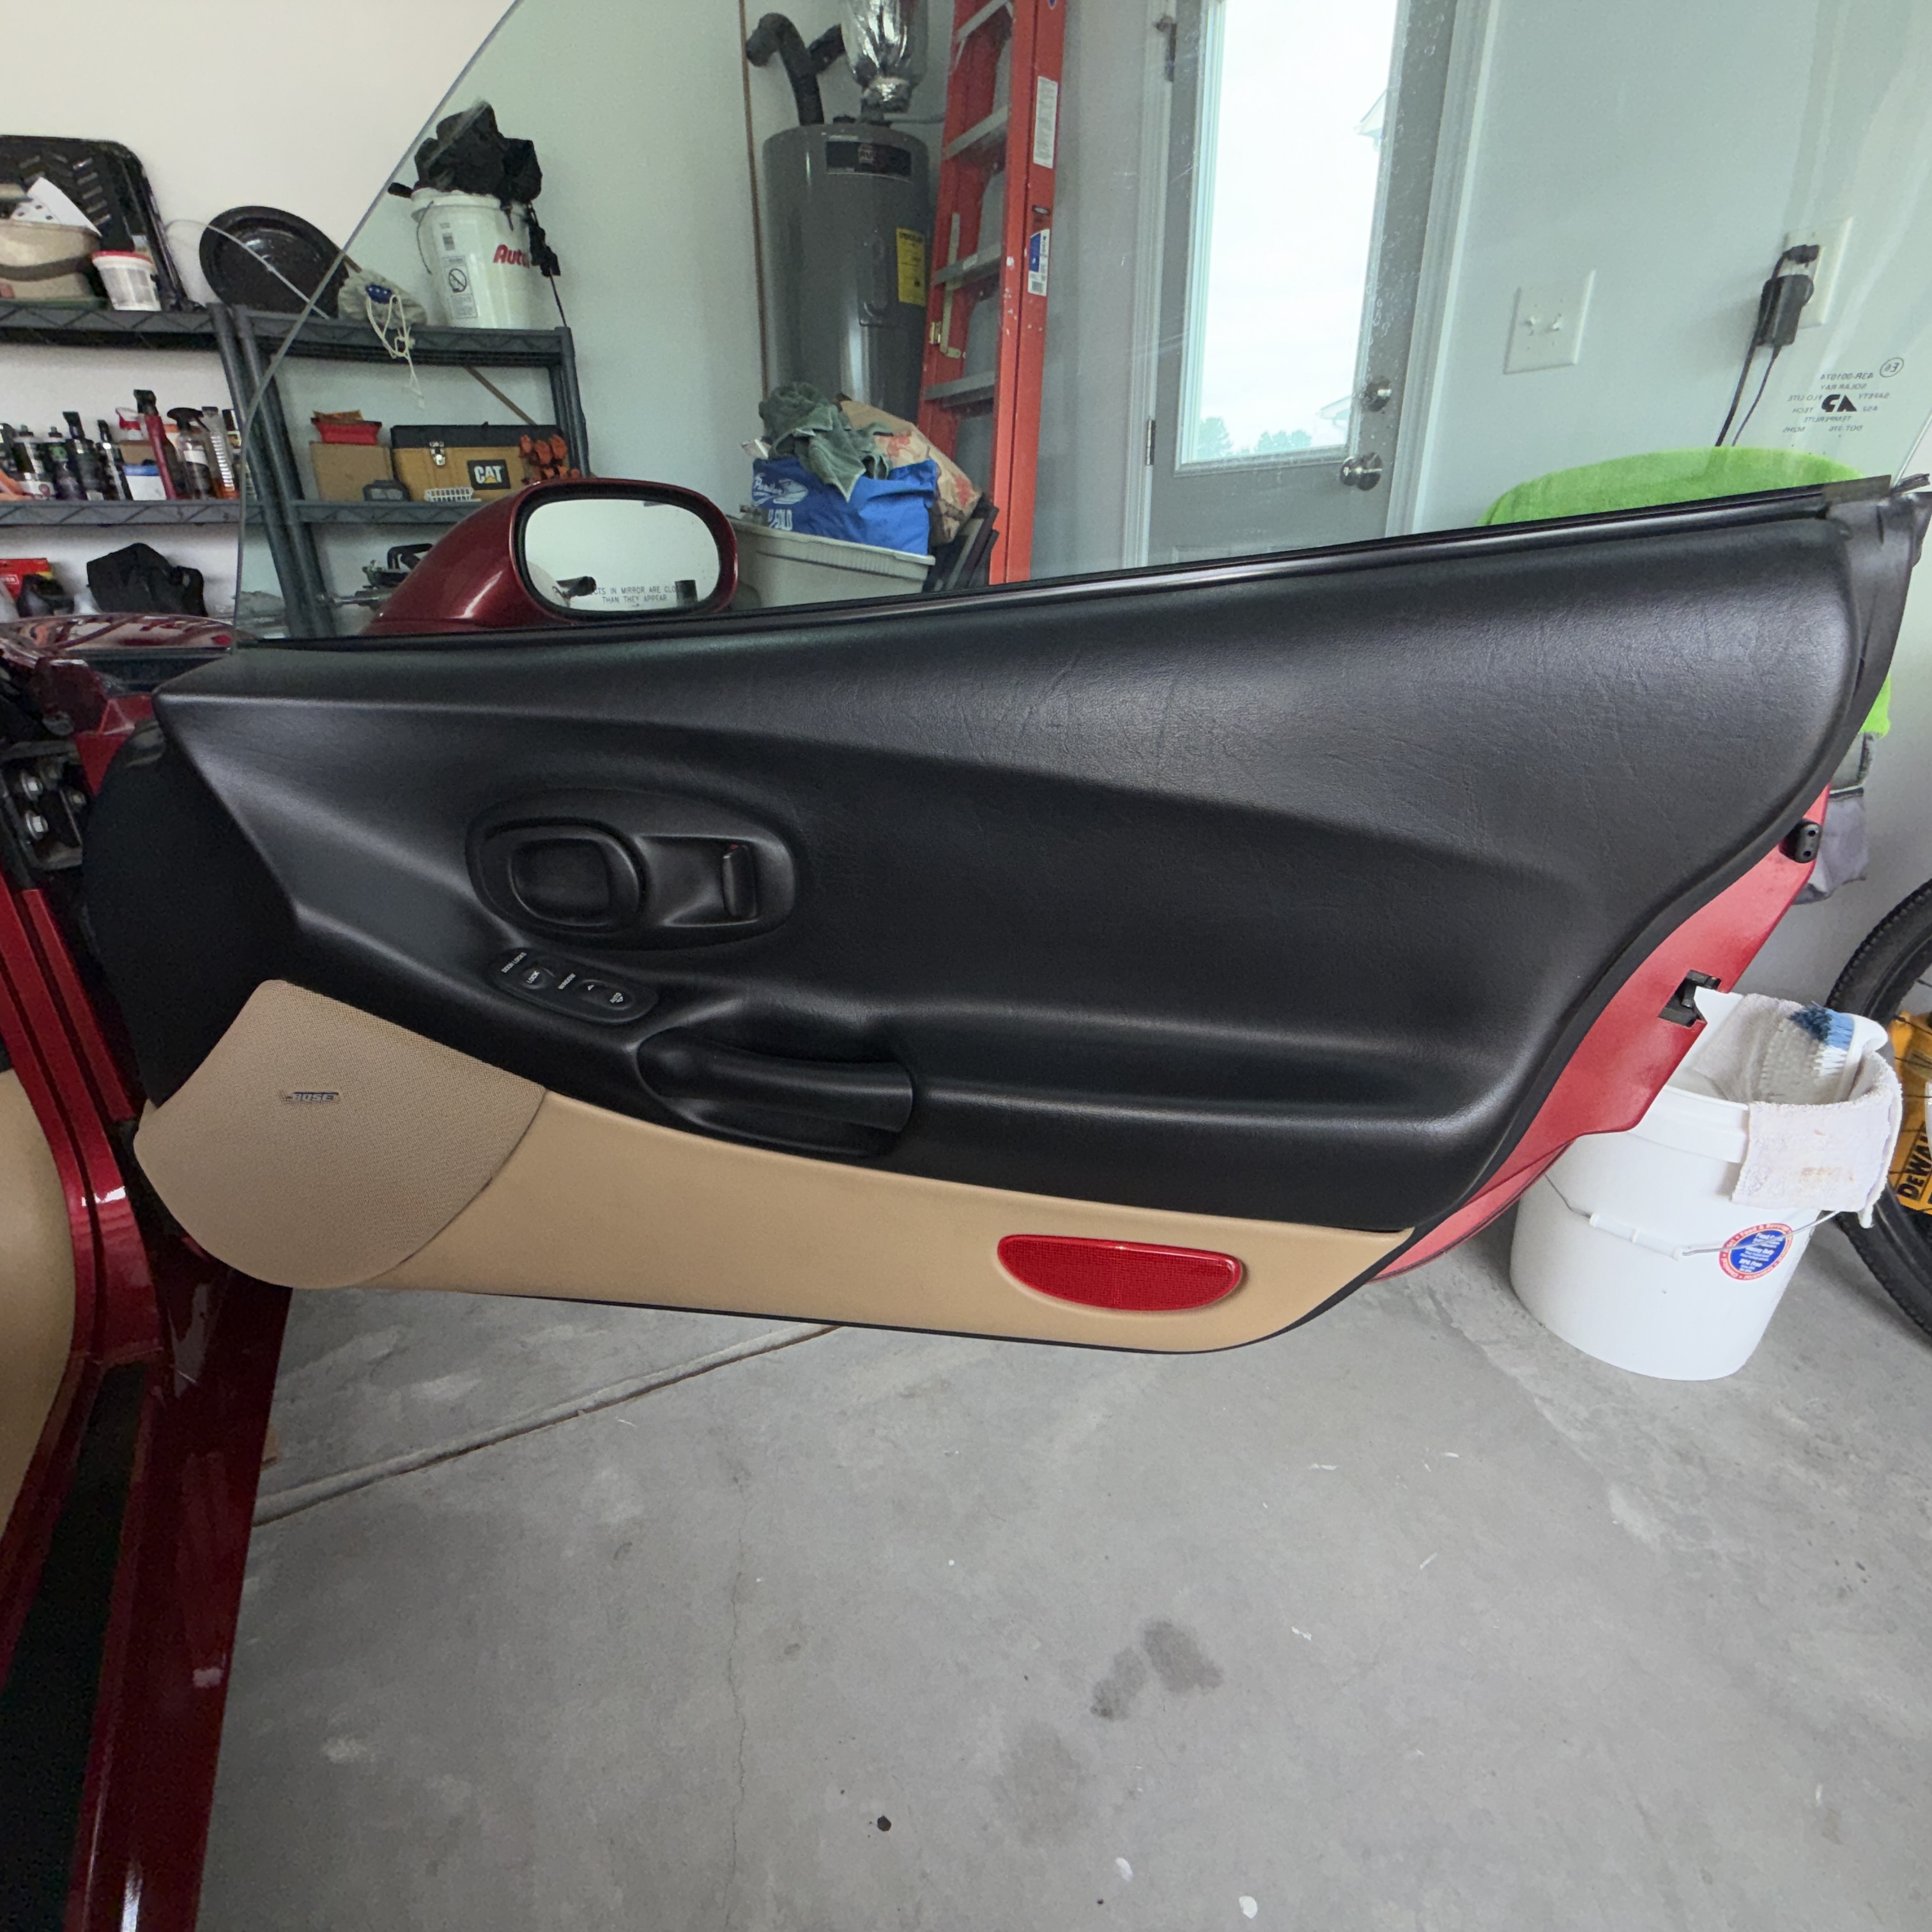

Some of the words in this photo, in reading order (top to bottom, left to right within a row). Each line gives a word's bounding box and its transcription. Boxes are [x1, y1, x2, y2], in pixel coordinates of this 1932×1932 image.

[474, 466, 502, 484] CAT
[526, 970, 540, 984] LOCK
[558, 972, 576, 990] WINDOW
[610, 992, 622, 1004] AUTO
[292, 1092, 337, 1101] BOSE
